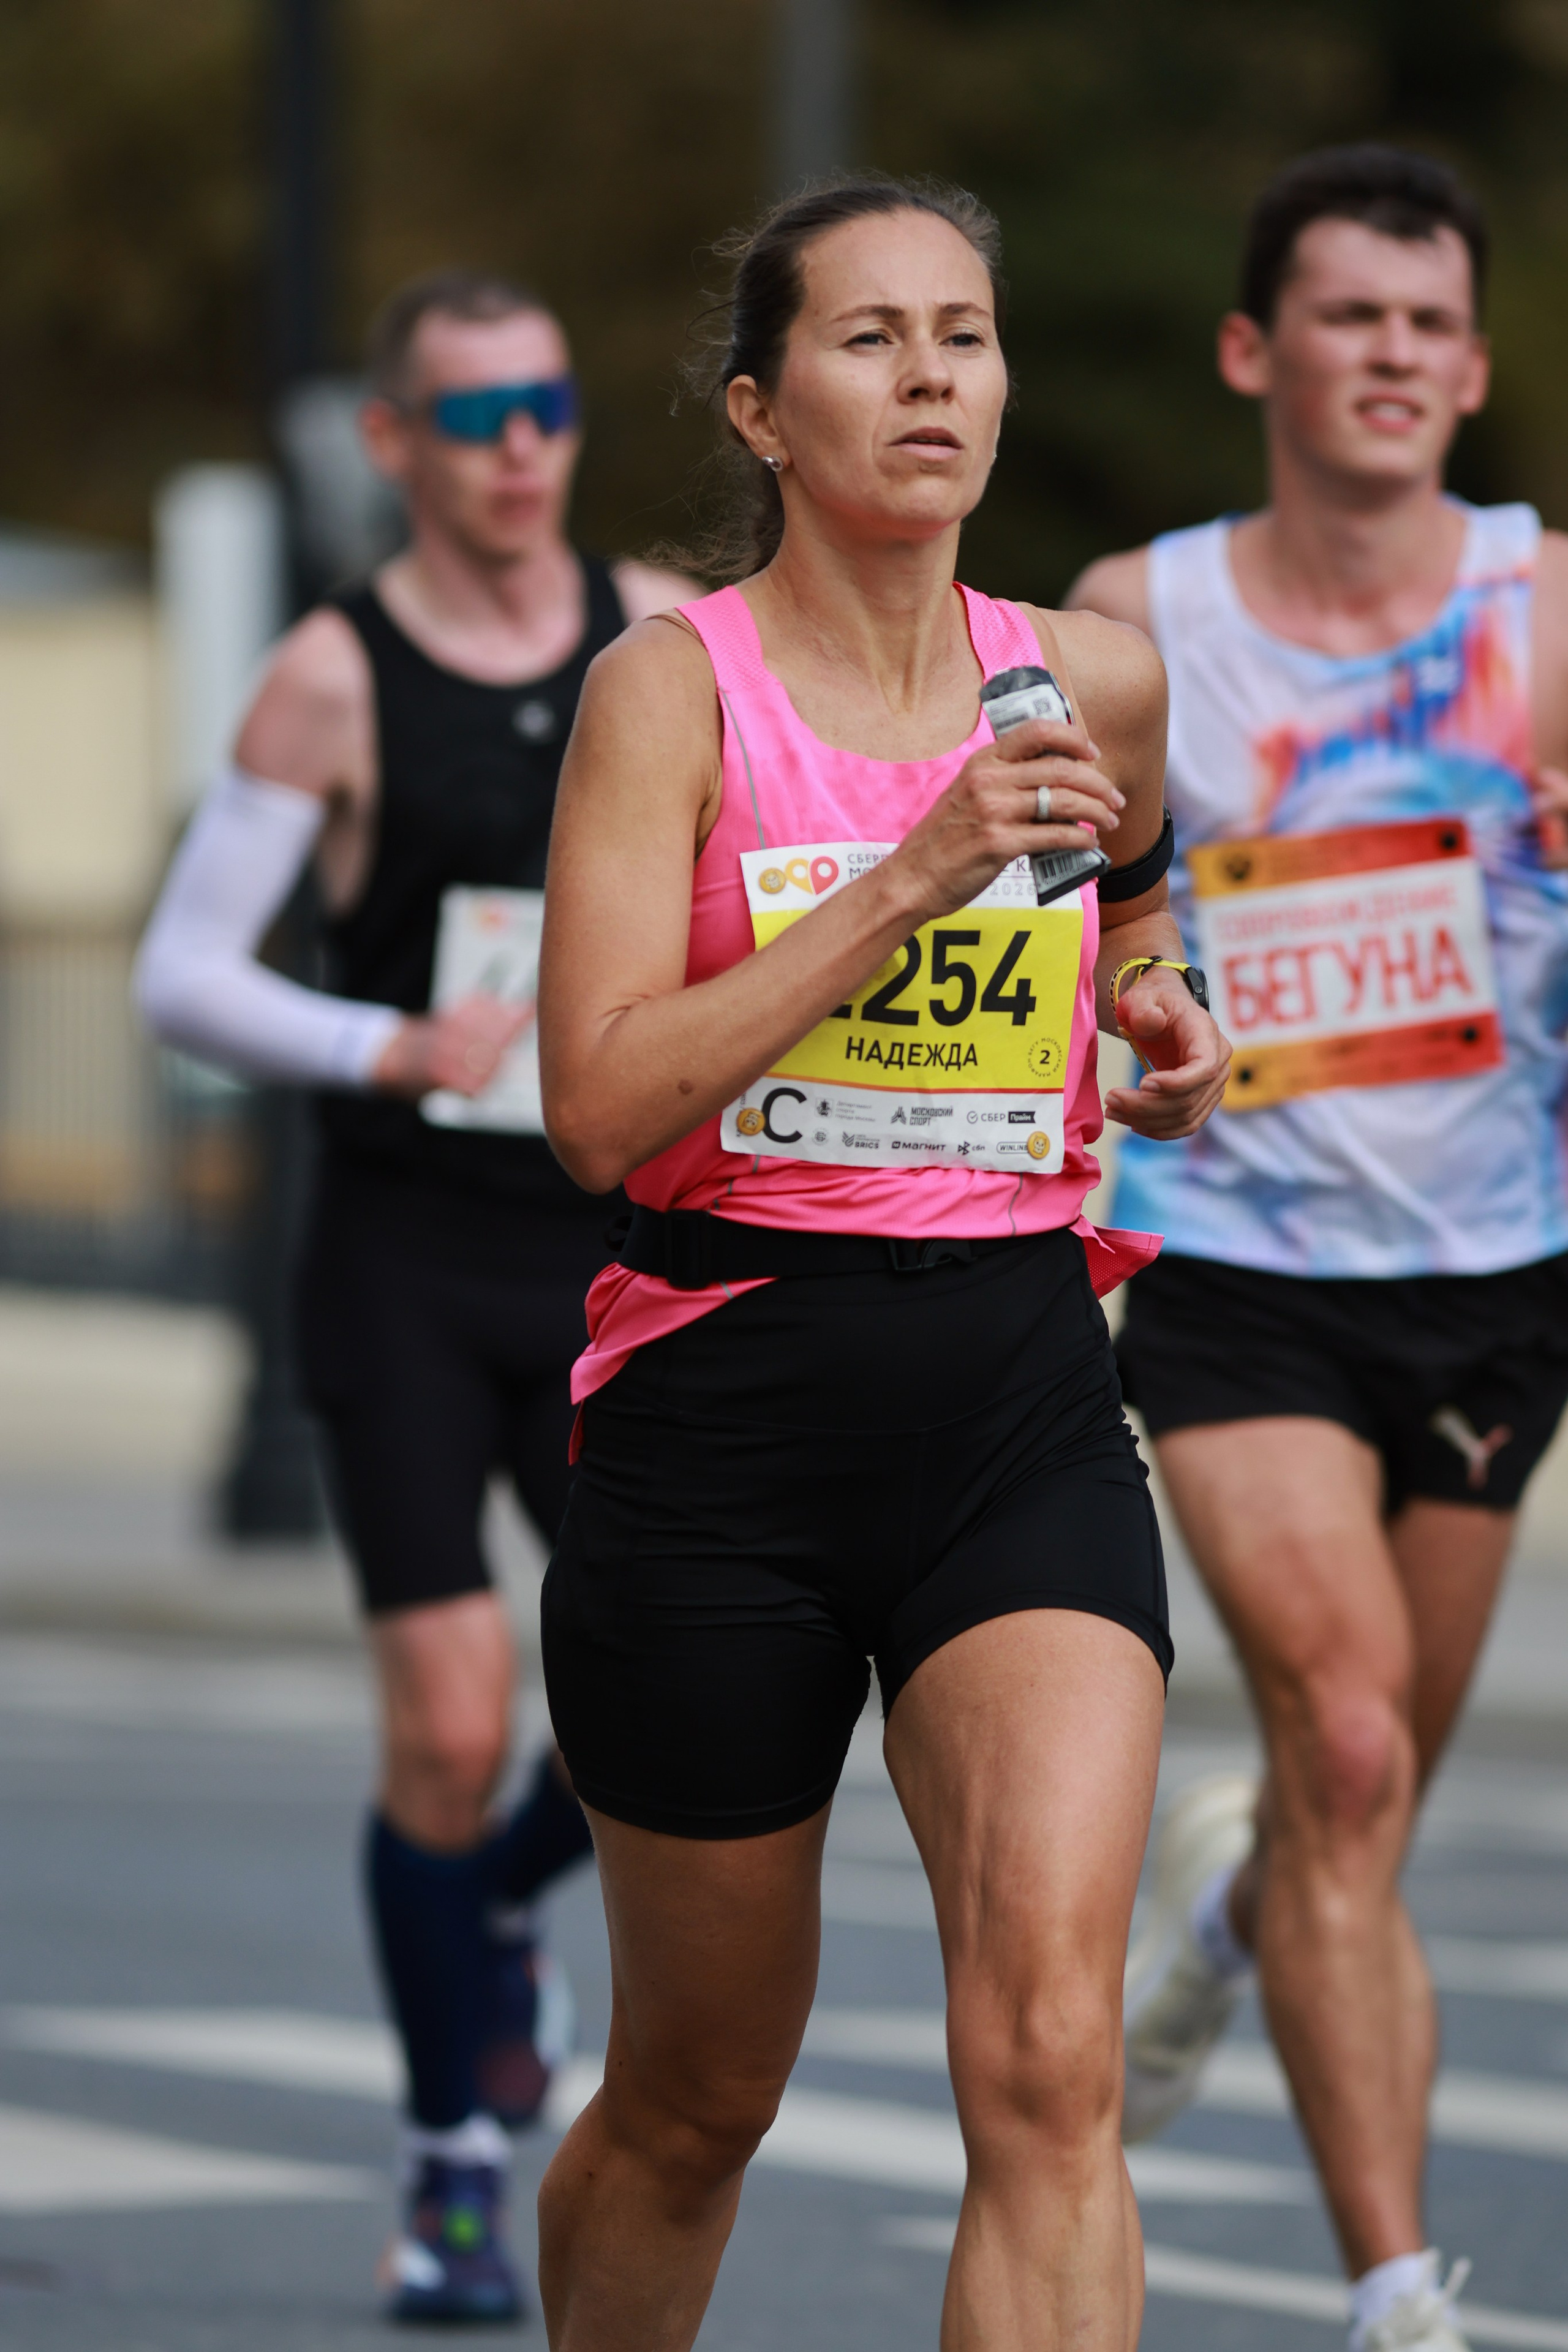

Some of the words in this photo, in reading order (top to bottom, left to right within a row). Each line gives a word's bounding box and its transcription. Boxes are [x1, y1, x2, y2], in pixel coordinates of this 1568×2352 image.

[828, 930, 1036, 1026] 254
[1223, 924, 1475, 1033] БЕГУНА
[845, 1036, 978, 1071] НАДЕЖДА
[1039, 1049, 1050, 1065] 2
[761, 1087, 807, 1144] C
[910, 1117, 931, 1126] СПОРТ
[911, 1106, 953, 1117] МОСКОВСКИЙ
[981, 1113, 1006, 1122] СБЕР
[1010, 1113, 1031, 1122] Прайм
